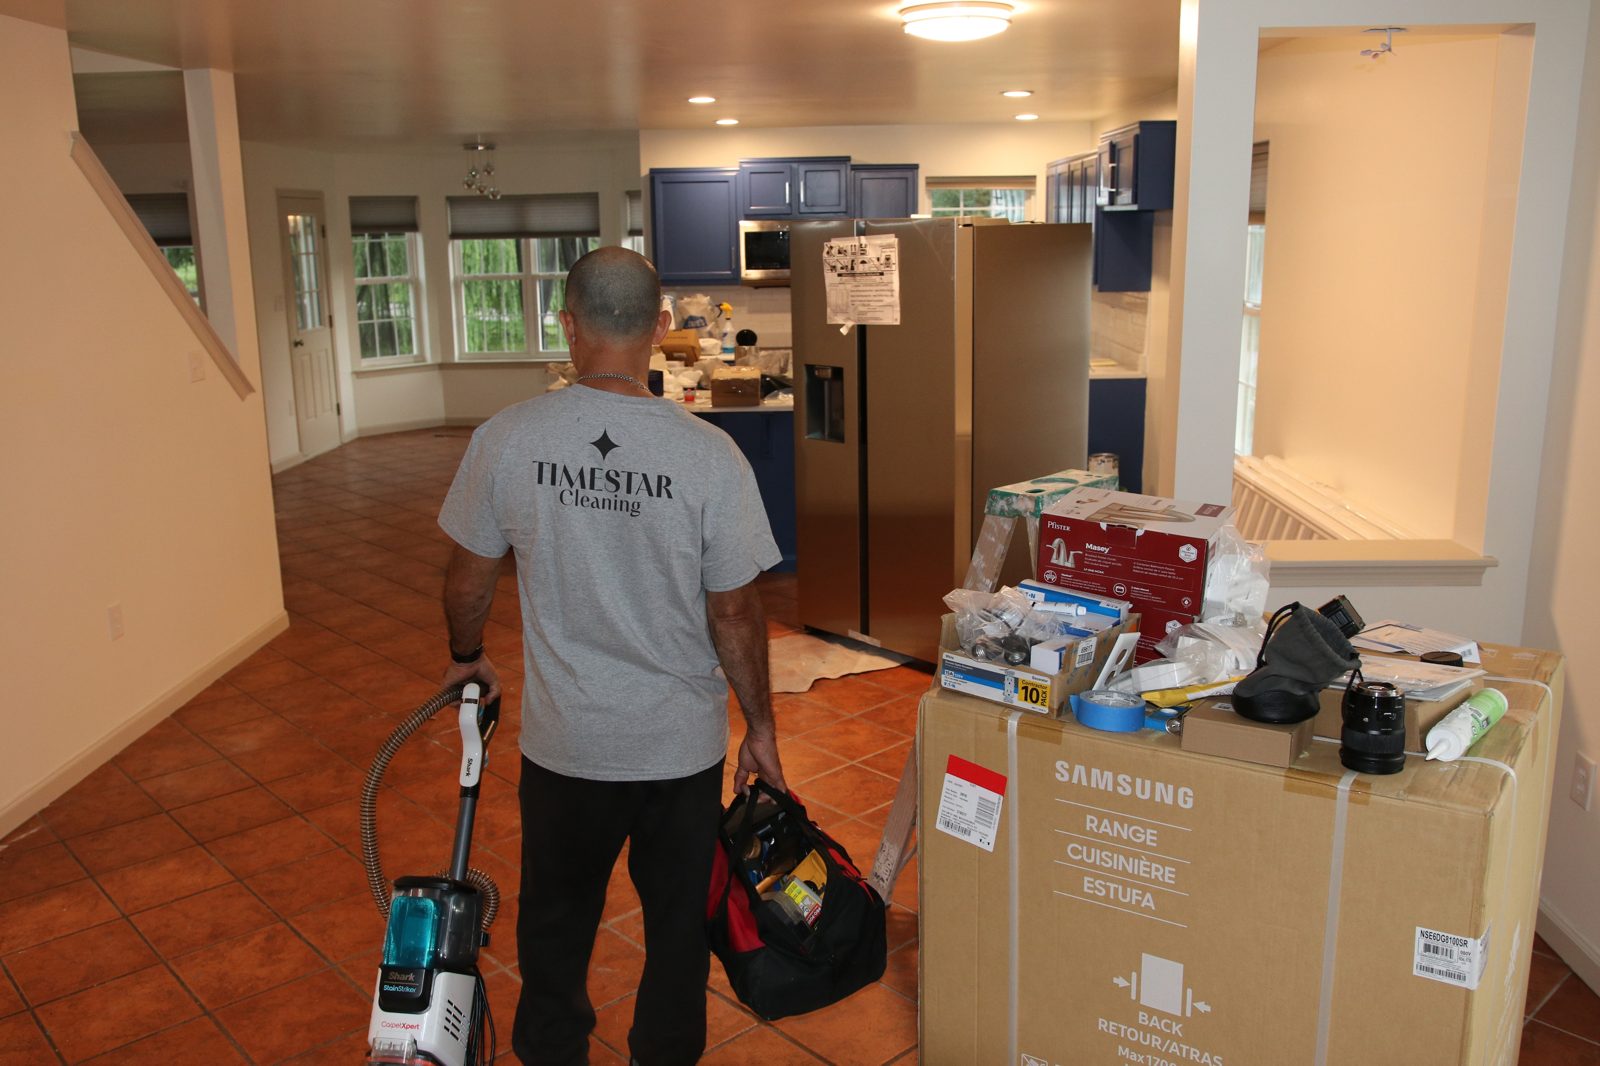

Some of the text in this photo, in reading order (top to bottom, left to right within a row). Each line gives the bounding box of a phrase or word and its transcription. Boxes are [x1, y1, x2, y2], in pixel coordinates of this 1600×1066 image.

[532, 460, 673, 499] TIMESTAR
[559, 489, 641, 517] Cleaning
[1085, 543, 1110, 553] Masey
[1021, 680, 1047, 690] Contractor
[1021, 685, 1040, 704] 10
[465, 757, 473, 777] Shark
[1055, 760, 1194, 809] SAMSUNG
[1086, 814, 1157, 847] RANGE
[1066, 843, 1176, 884] CUISINIÈRE
[1083, 876, 1155, 910] ESTUFA
[388, 971, 415, 981] Shark
[382, 1021, 420, 1029] CarpetXpert
[1138, 1011, 1183, 1037] BACK
[1098, 1018, 1223, 1066] RETOUR/ATRAS
